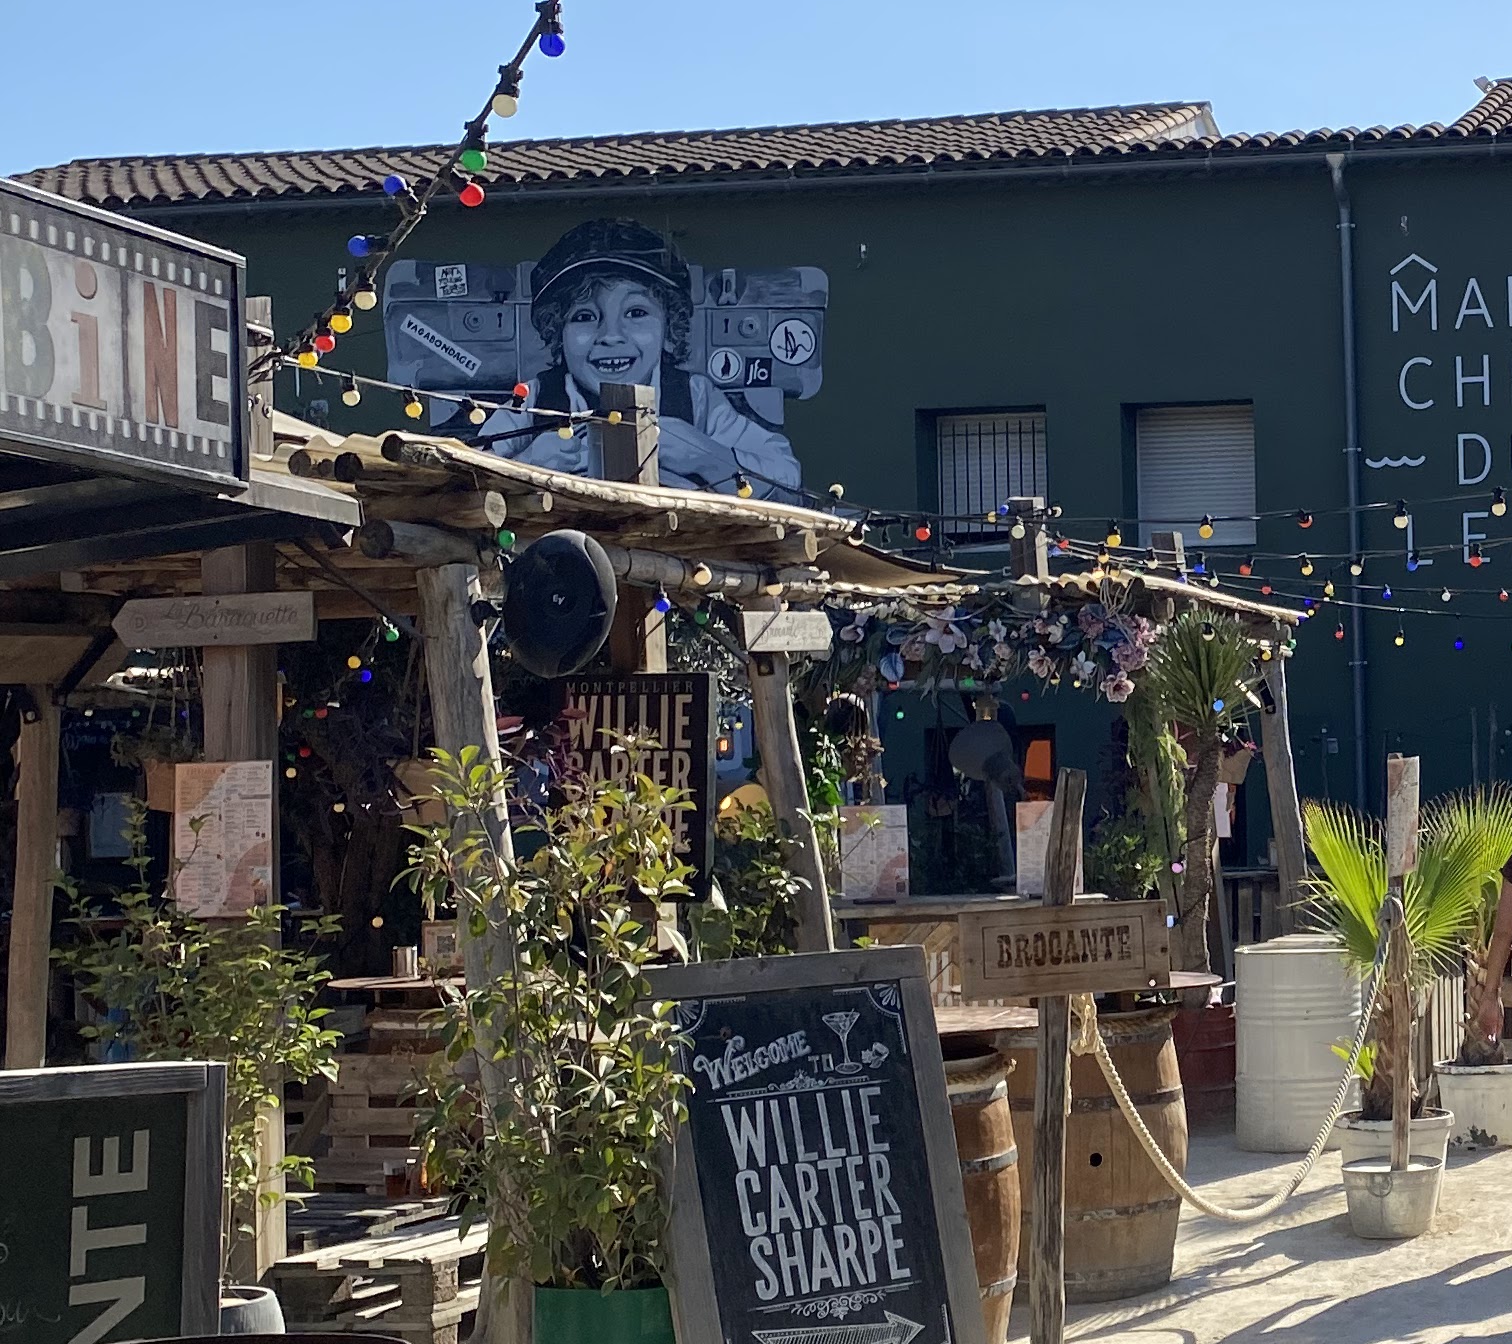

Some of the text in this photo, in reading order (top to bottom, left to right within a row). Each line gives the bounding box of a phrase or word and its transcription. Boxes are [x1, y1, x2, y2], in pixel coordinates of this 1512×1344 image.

[405, 318, 479, 373] VAGABONDAGES
[565, 679, 694, 695] MONTPELLIER
[567, 693, 694, 750] WILLIE
[997, 924, 1133, 969] BROCANTE
[692, 1030, 834, 1091] WELCOME TO
[720, 1086, 891, 1172] WILLIE
[735, 1152, 902, 1238] CARTER
[750, 1215, 912, 1301] SHARPE
